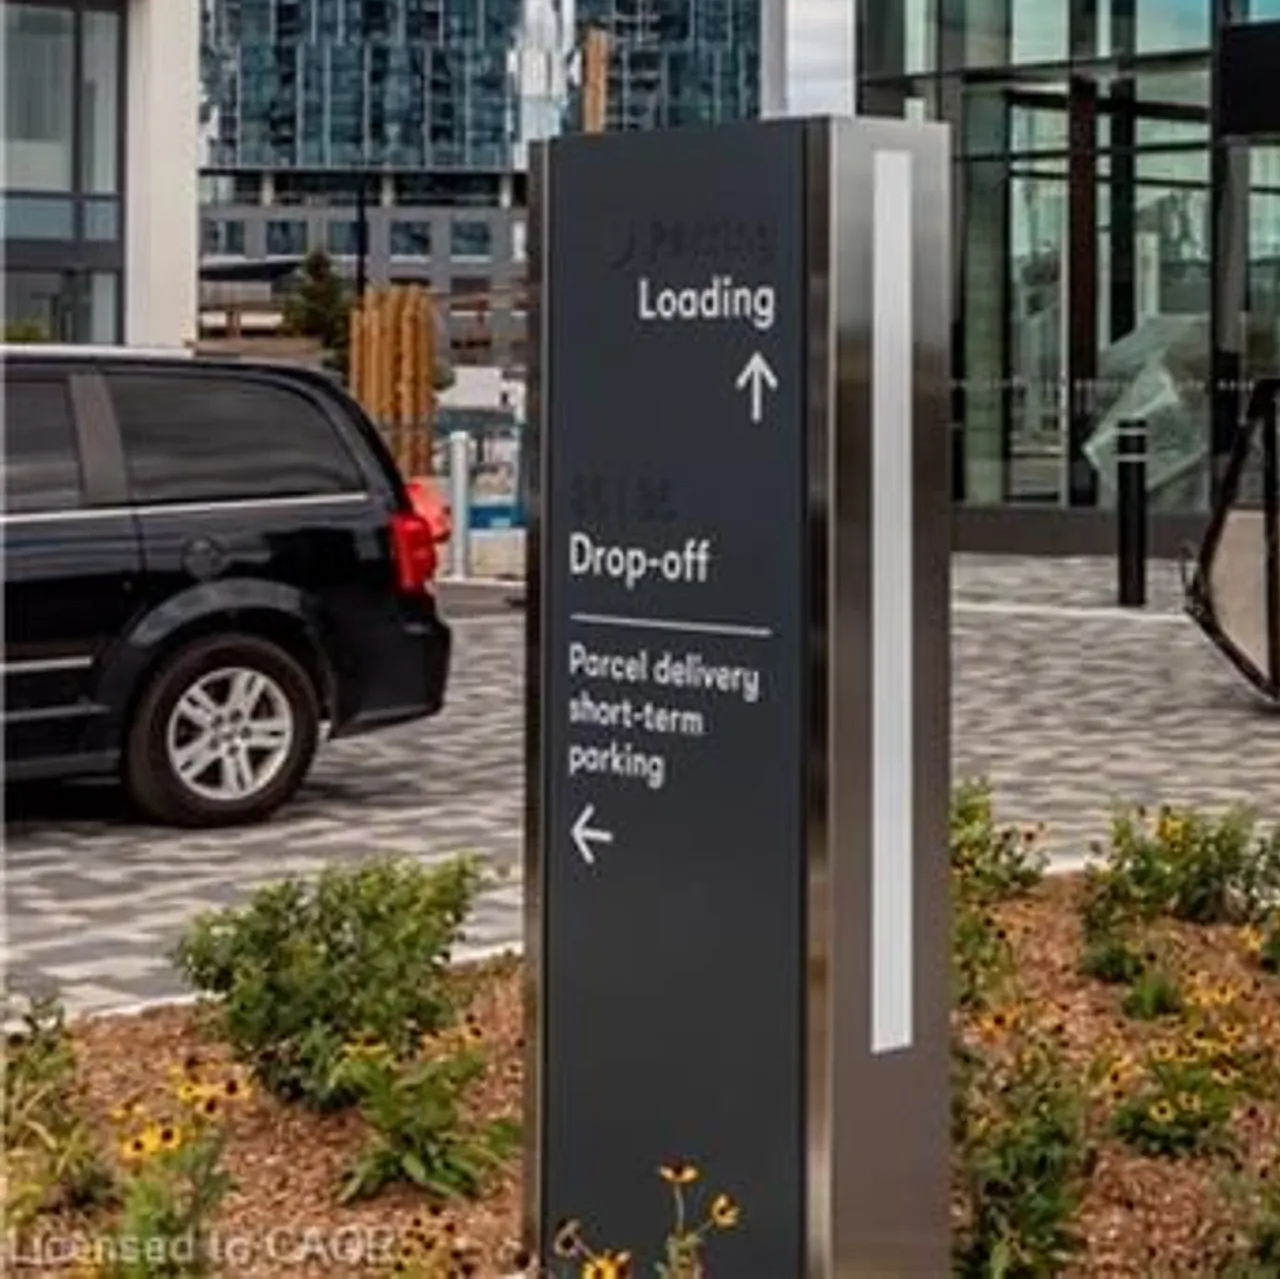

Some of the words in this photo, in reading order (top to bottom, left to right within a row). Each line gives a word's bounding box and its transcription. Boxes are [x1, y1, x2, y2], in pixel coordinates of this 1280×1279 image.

[638, 275, 775, 330] Loading
[569, 532, 710, 590] Drop-off
[569, 641, 648, 682] Parcel
[653, 652, 759, 703] delivery
[569, 690, 704, 735] short-term
[569, 741, 664, 789] parking
